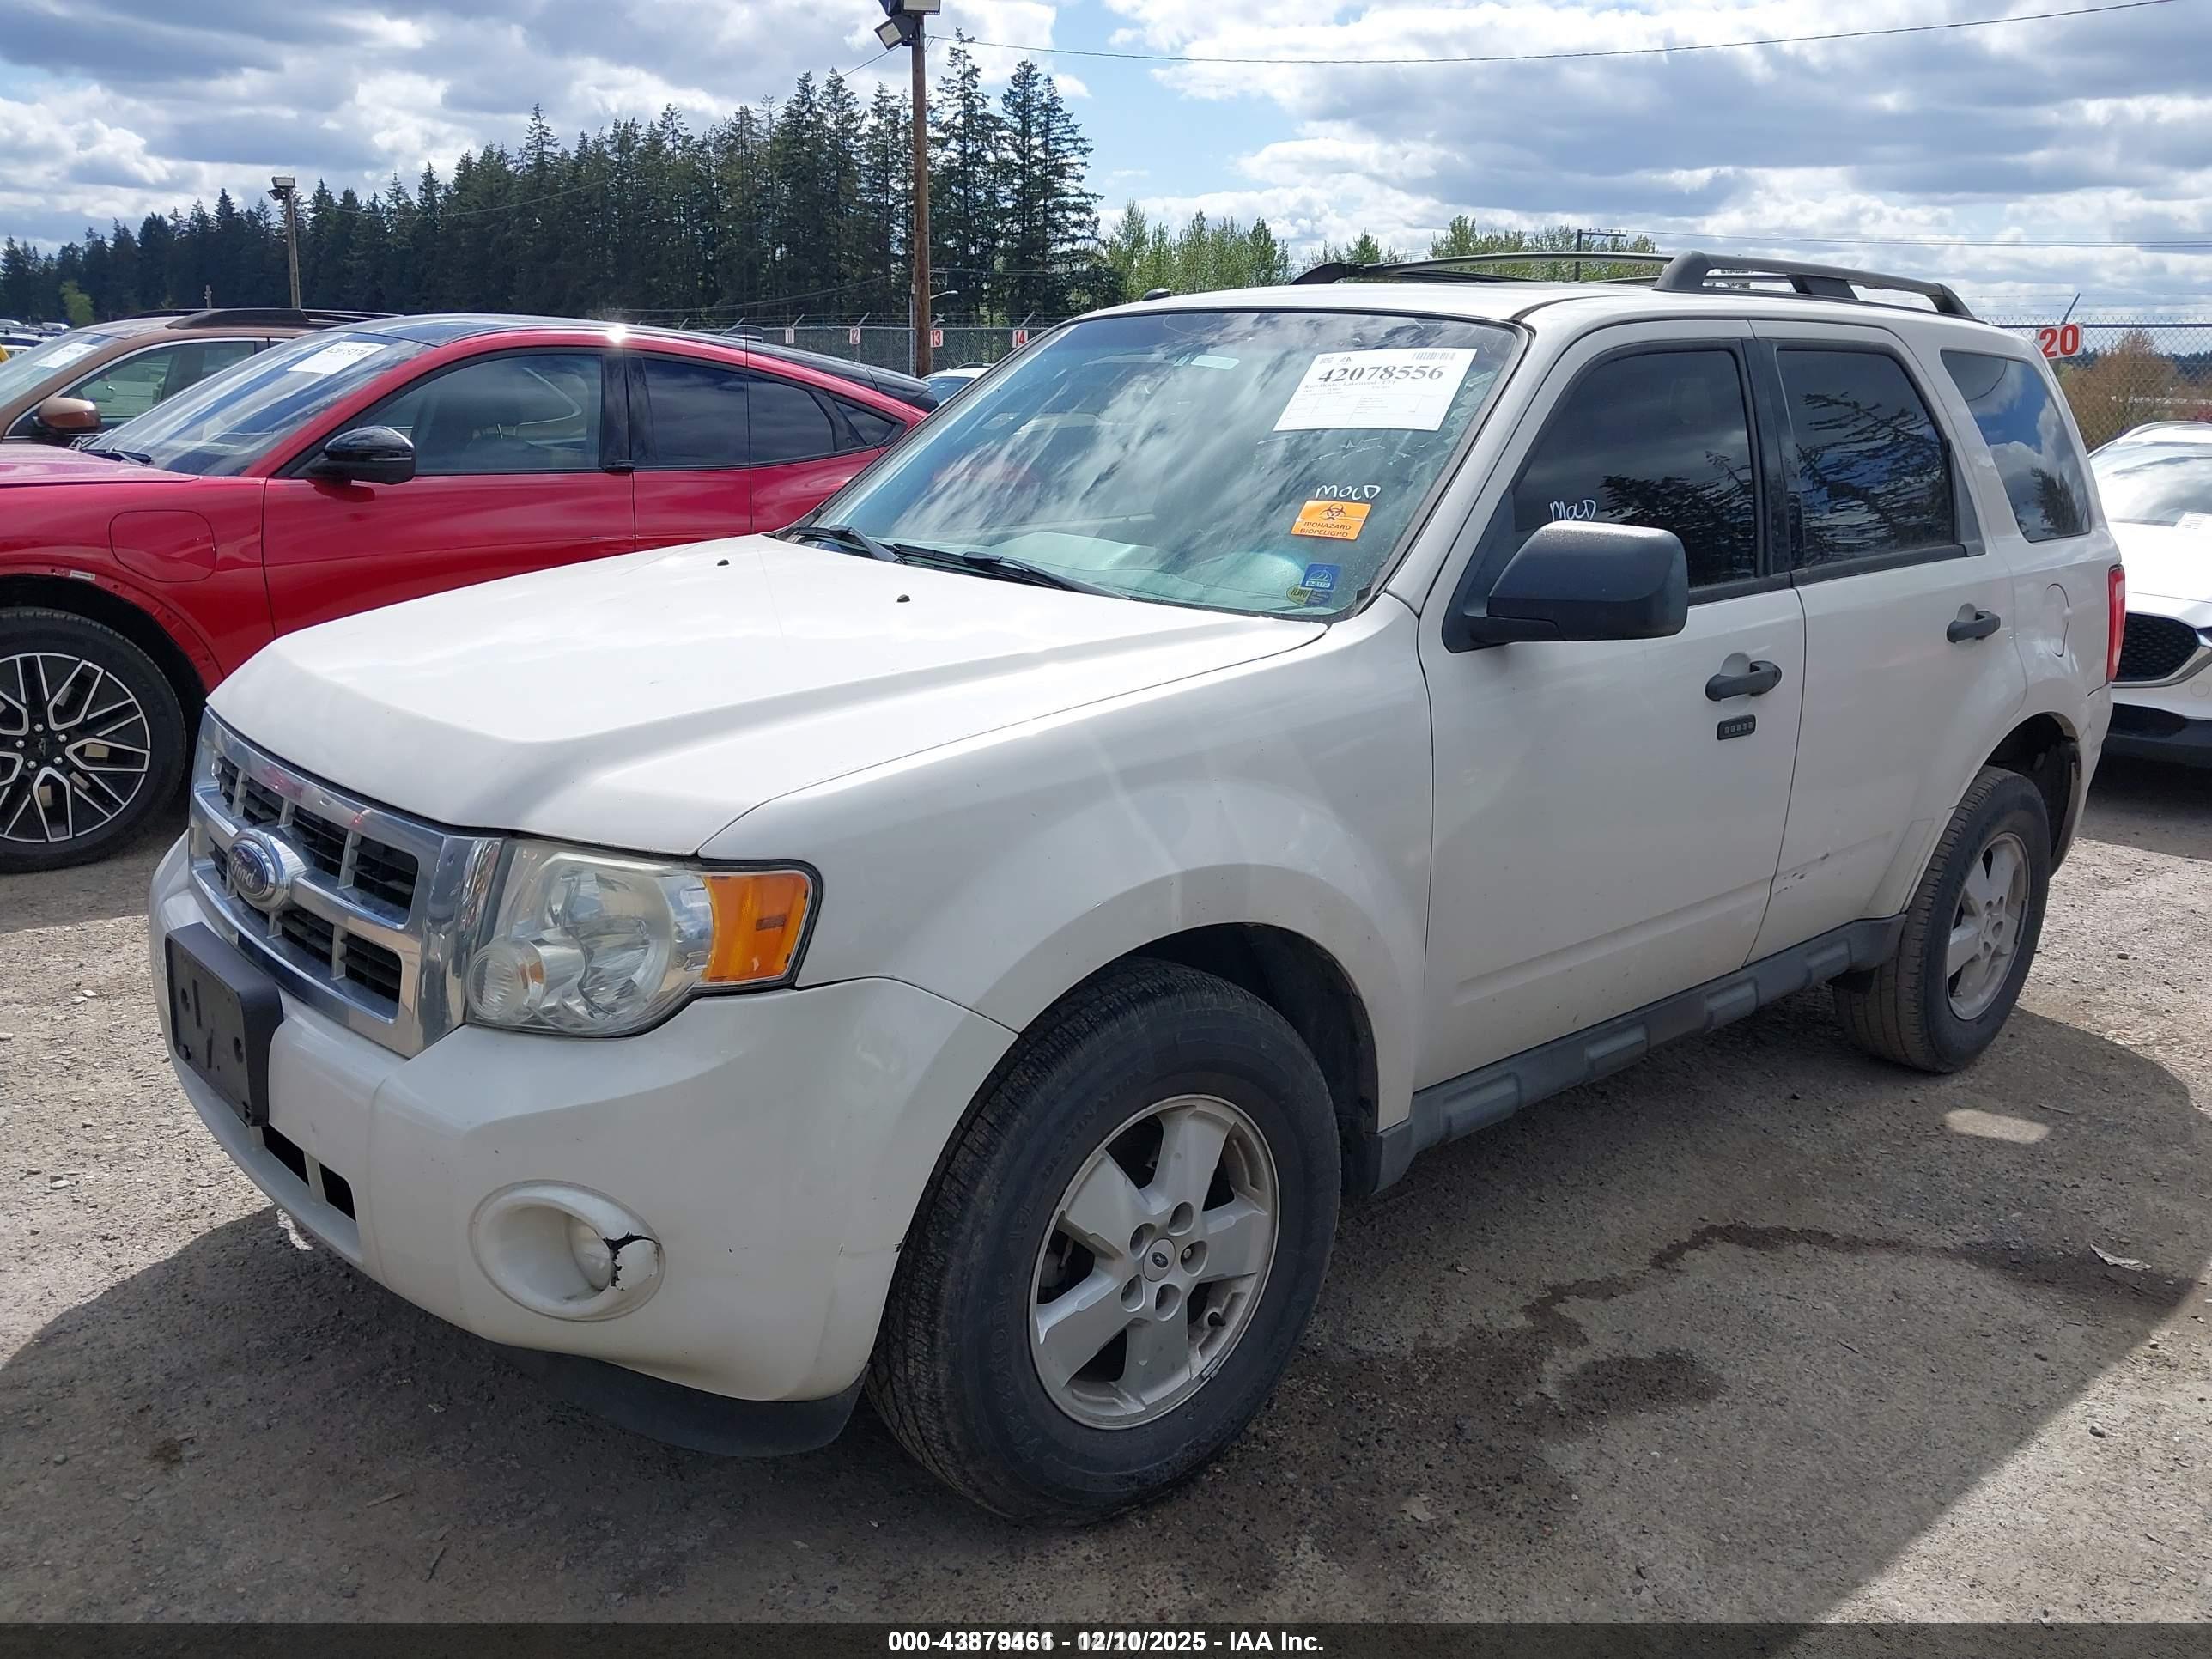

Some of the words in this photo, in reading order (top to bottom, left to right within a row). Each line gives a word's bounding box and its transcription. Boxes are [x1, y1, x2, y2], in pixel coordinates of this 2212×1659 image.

[851, 329, 859, 343] 12
[931, 331, 941, 345] 13
[1015, 331, 1025, 346] 14
[2039, 325, 2079, 357] 20
[1318, 366, 1444, 382] 42078556
[1299, 528, 1348, 538] BIOPELIGRO
[1304, 521, 1352, 531] BIOHAZARD
